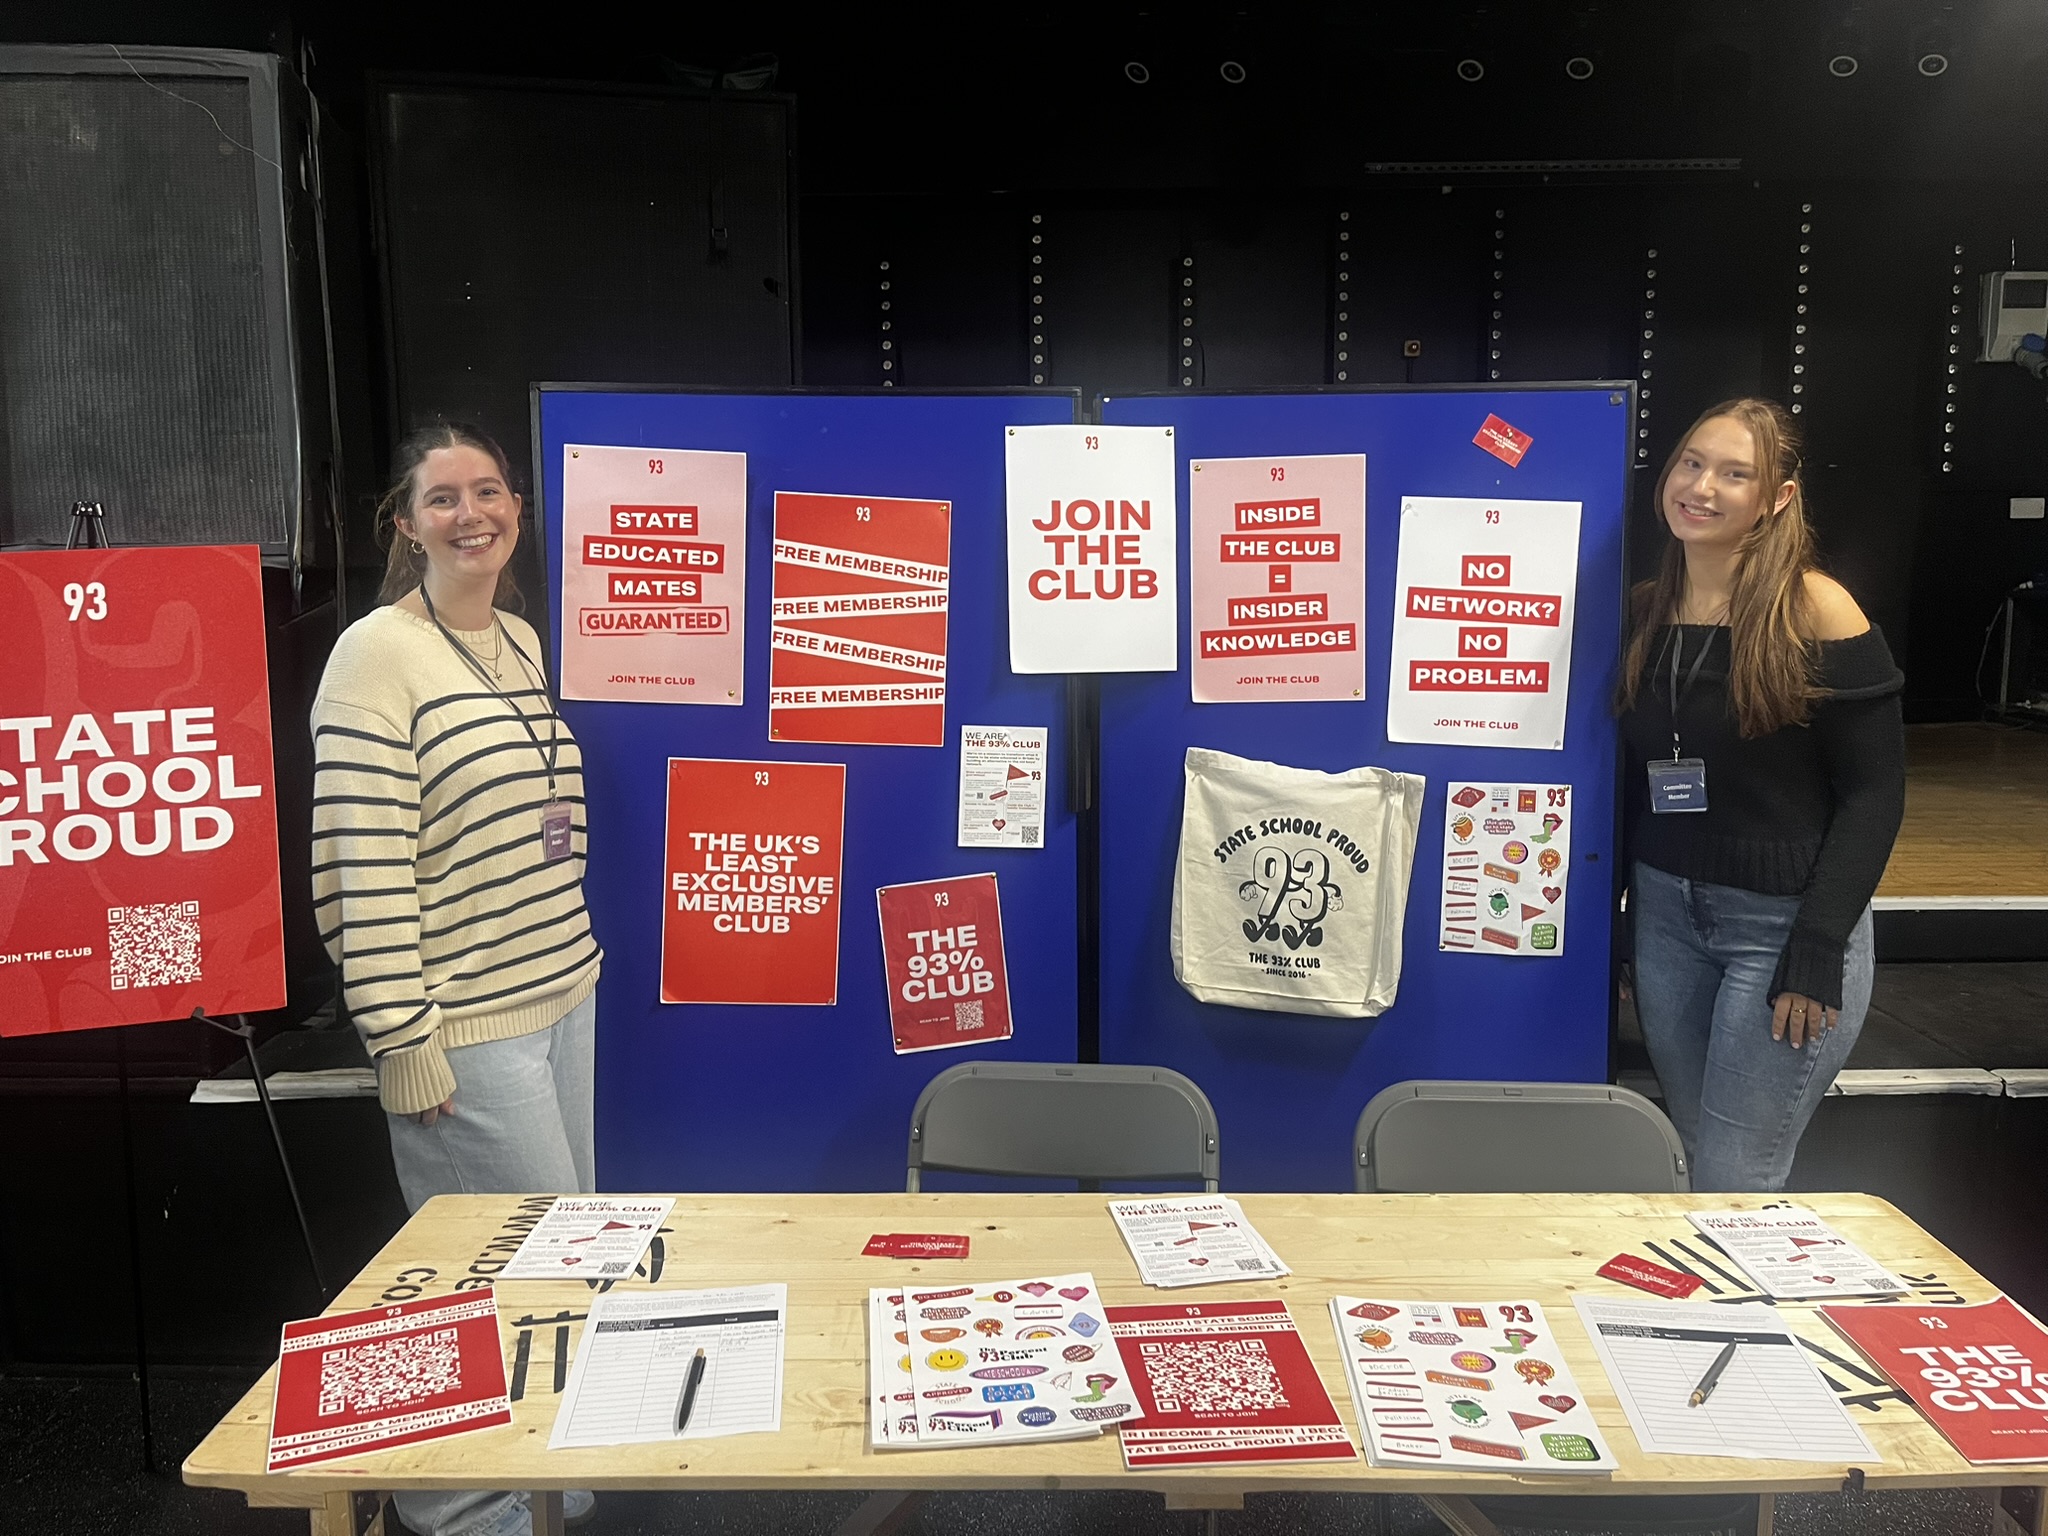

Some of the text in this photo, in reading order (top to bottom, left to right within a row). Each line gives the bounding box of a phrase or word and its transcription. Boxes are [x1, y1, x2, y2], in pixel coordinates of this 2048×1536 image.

[1086, 436, 1098, 450] 93
[649, 460, 663, 474] 93
[1270, 467, 1284, 482] 93
[616, 512, 693, 529] STATE
[856, 507, 870, 522] 93
[1032, 500, 1151, 531] JOIN
[1240, 505, 1315, 522] INSIDE
[1485, 510, 1499, 524] 93
[588, 543, 719, 566] EDUCATED
[1044, 535, 1140, 566] THE
[1226, 540, 1335, 556] THE CLUB
[774, 545, 948, 584] FREE MEMBERSHIP
[1468, 562, 1504, 579] NO
[614, 580, 696, 597] MATES
[1028, 569, 1158, 600] CLUB
[63, 582, 107, 621] 93
[773, 595, 947, 616] FREE MEMBERSHIP
[1233, 601, 1322, 618] INSIDER
[1412, 595, 1555, 616] NETWORK?
[586, 613, 722, 630] GUARANTEED
[1206, 630, 1350, 651] KNOWLEDGE
[1464, 634, 1502, 650] NO
[773, 631, 945, 672] FREE MEMBERSHIP
[608, 675, 695, 685] JOIN THE CLUB
[1237, 676, 1263, 684] JOIN
[1416, 668, 1542, 686] PROBLEM.
[771, 688, 944, 704] FREE MEMBERSHIP
[1433, 718, 1518, 729] JOIN THE CLUB
[755, 772, 768, 786] 93
[1032, 771, 1041, 780] 93
[1548, 789, 1565, 807] 93
[689, 833, 747, 851] THE
[1213, 818, 1369, 874] STATE SCHOOL PROUD
[705, 854, 798, 874] LEAST
[673, 873, 833, 894] EXCLUSIVE
[1253, 846, 1329, 922] 93
[677, 894, 827, 914] MEMBERS'
[934, 893, 949, 907] 93
[713, 915, 790, 933] CLUB
[908, 925, 977, 953] THE
[24, 951, 52, 961] THE
[55, 947, 92, 958] CLUB
[1249, 952, 1321, 969] THE 93% CLUB
[908, 949, 984, 978] 93%
[1288, 970, 1307, 979] 2016
[902, 971, 994, 1002] CLUB
[329, 1299, 495, 1339] PROUD STATE SCHOOL
[387, 1308, 401, 1316] 93
[1186, 1308, 1200, 1316] 93
[1499, 1305, 1533, 1322] 93
[335, 1326, 397, 1343] BECOME
[413, 1313, 474, 1327] MEMBER
[1139, 1314, 1290, 1328] PROUD STATE SCHOOL
[1919, 1317, 1948, 1329] 93
[980, 1347, 1047, 1362] 93 Percent
[1899, 1345, 2032, 1366] THE
[997, 1367, 1025, 1378] SCHOOL
[926, 1388, 970, 1397] APPROVED
[386, 1402, 399, 1410] TO
[402, 1398, 425, 1407] JOIN
[302, 1425, 370, 1440] BECOME
[388, 1407, 455, 1425] MEMBER
[316, 1432, 384, 1451] SCHOOL
[389, 1418, 444, 1436] PROUD
[455, 1404, 505, 1421] STATE
[929, 1421, 946, 1431] 93
[1230, 1428, 1294, 1436] MEMBER
[1167, 1441, 1231, 1451] SCHOOL
[1235, 1437, 1286, 1447] PROUD
